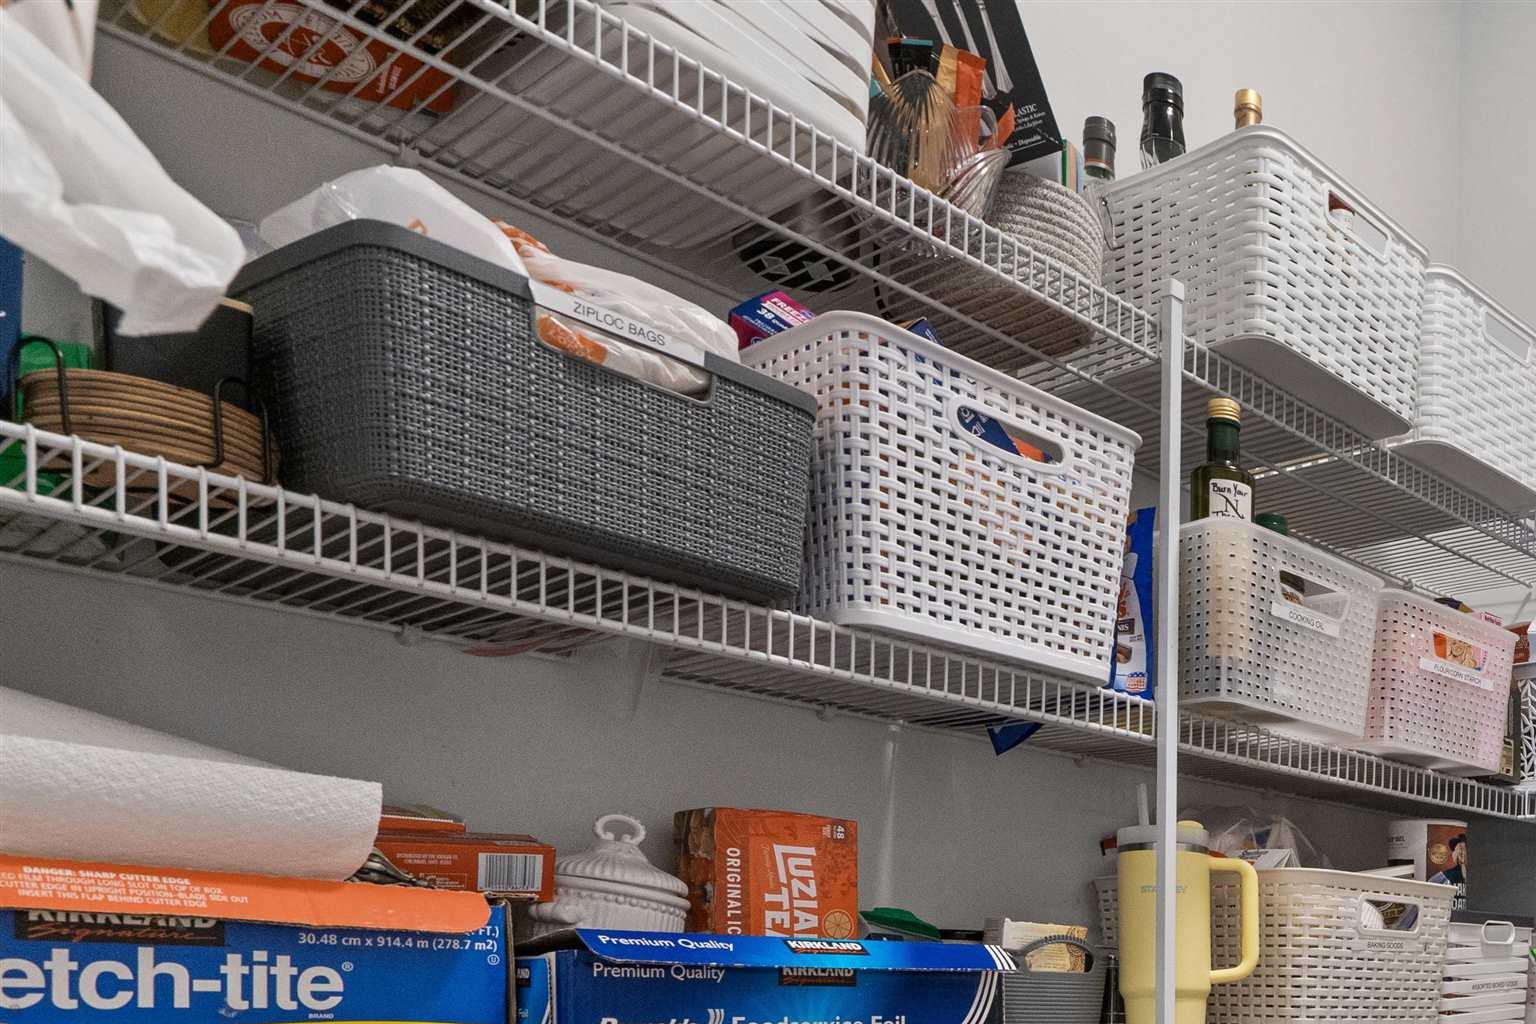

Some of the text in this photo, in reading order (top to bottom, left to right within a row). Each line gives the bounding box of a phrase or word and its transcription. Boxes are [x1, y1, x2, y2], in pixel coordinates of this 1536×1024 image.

[573, 301, 667, 347] ZIPLOC BAGS
[1211, 481, 1249, 499] Burn Your
[836, 825, 845, 840] 48
[22, 865, 191, 886] DANGER: SHARP CUTTER EDGE
[726, 847, 742, 918] ORIGINAL
[772, 843, 819, 939] LUZIA
[298, 932, 498, 952] 30.48 cm 914.4 m (278.7 m2)
[597, 934, 735, 954] Premium Quality
[786, 938, 863, 953] KIRKLAND
[0, 946, 345, 1012] etch-tite
[592, 961, 725, 983] Premium Quality
